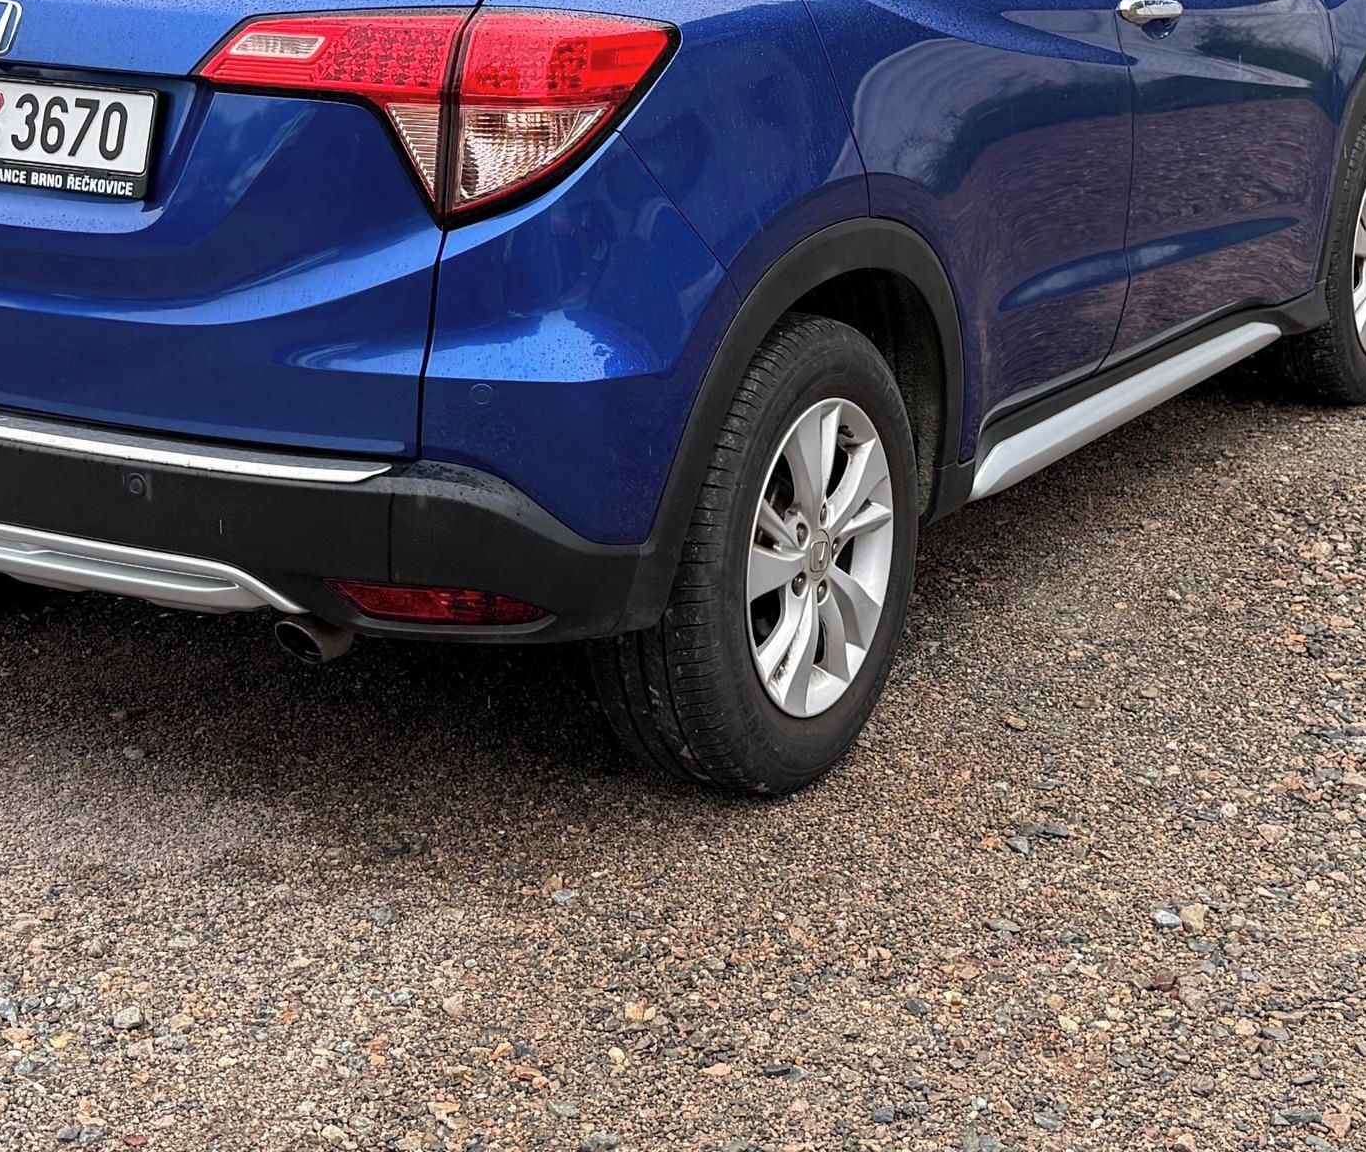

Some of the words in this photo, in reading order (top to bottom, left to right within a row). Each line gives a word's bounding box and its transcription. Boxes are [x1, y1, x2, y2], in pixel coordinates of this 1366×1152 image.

[10, 93, 129, 162] 3670
[30, 171, 64, 189] BRNO
[66, 173, 134, 197] ŘEČKOVICE
